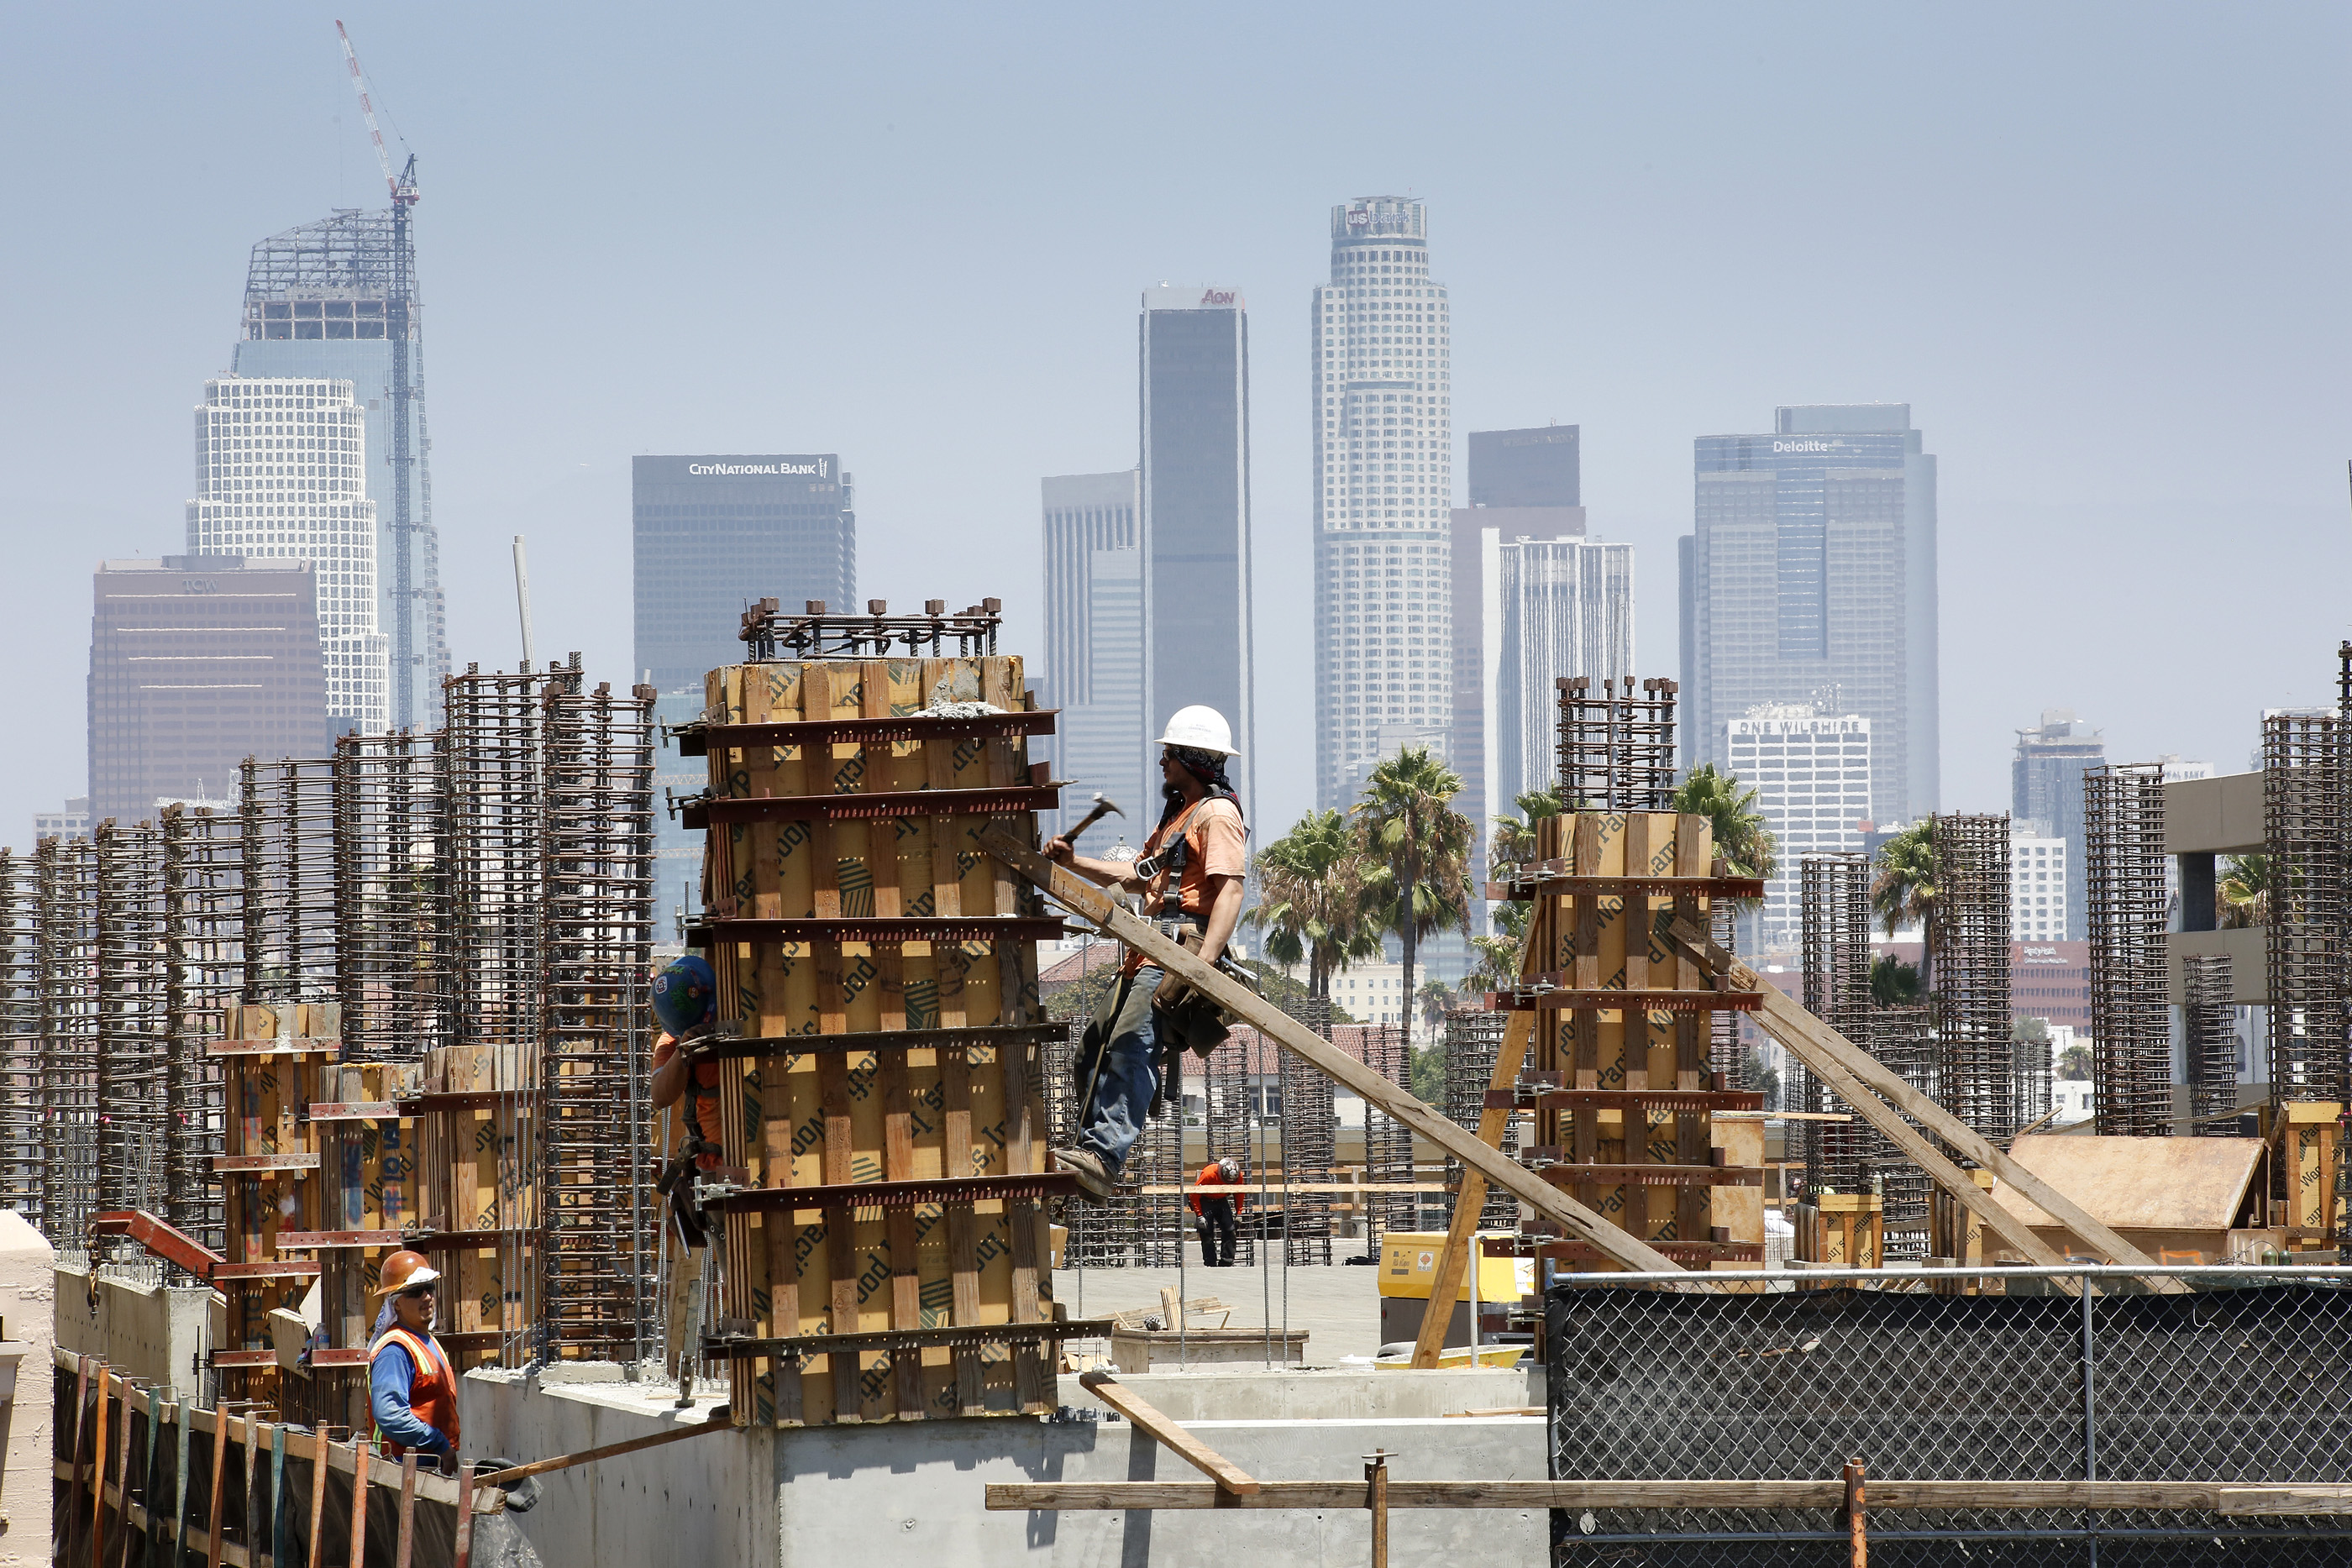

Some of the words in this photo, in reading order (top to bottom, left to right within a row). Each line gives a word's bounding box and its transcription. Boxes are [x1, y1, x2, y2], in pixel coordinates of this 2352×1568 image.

[1369, 210, 1410, 224] bank
[1200, 288, 1236, 304] AON
[1773, 440, 1828, 453] Deloitte
[715, 463, 779, 475] NATIONAL
[780, 462, 816, 475] BANK
[181, 579, 219, 594] TCW
[1740, 721, 1772, 735] ONE
[1780, 720, 1859, 735] WILSHIRE
